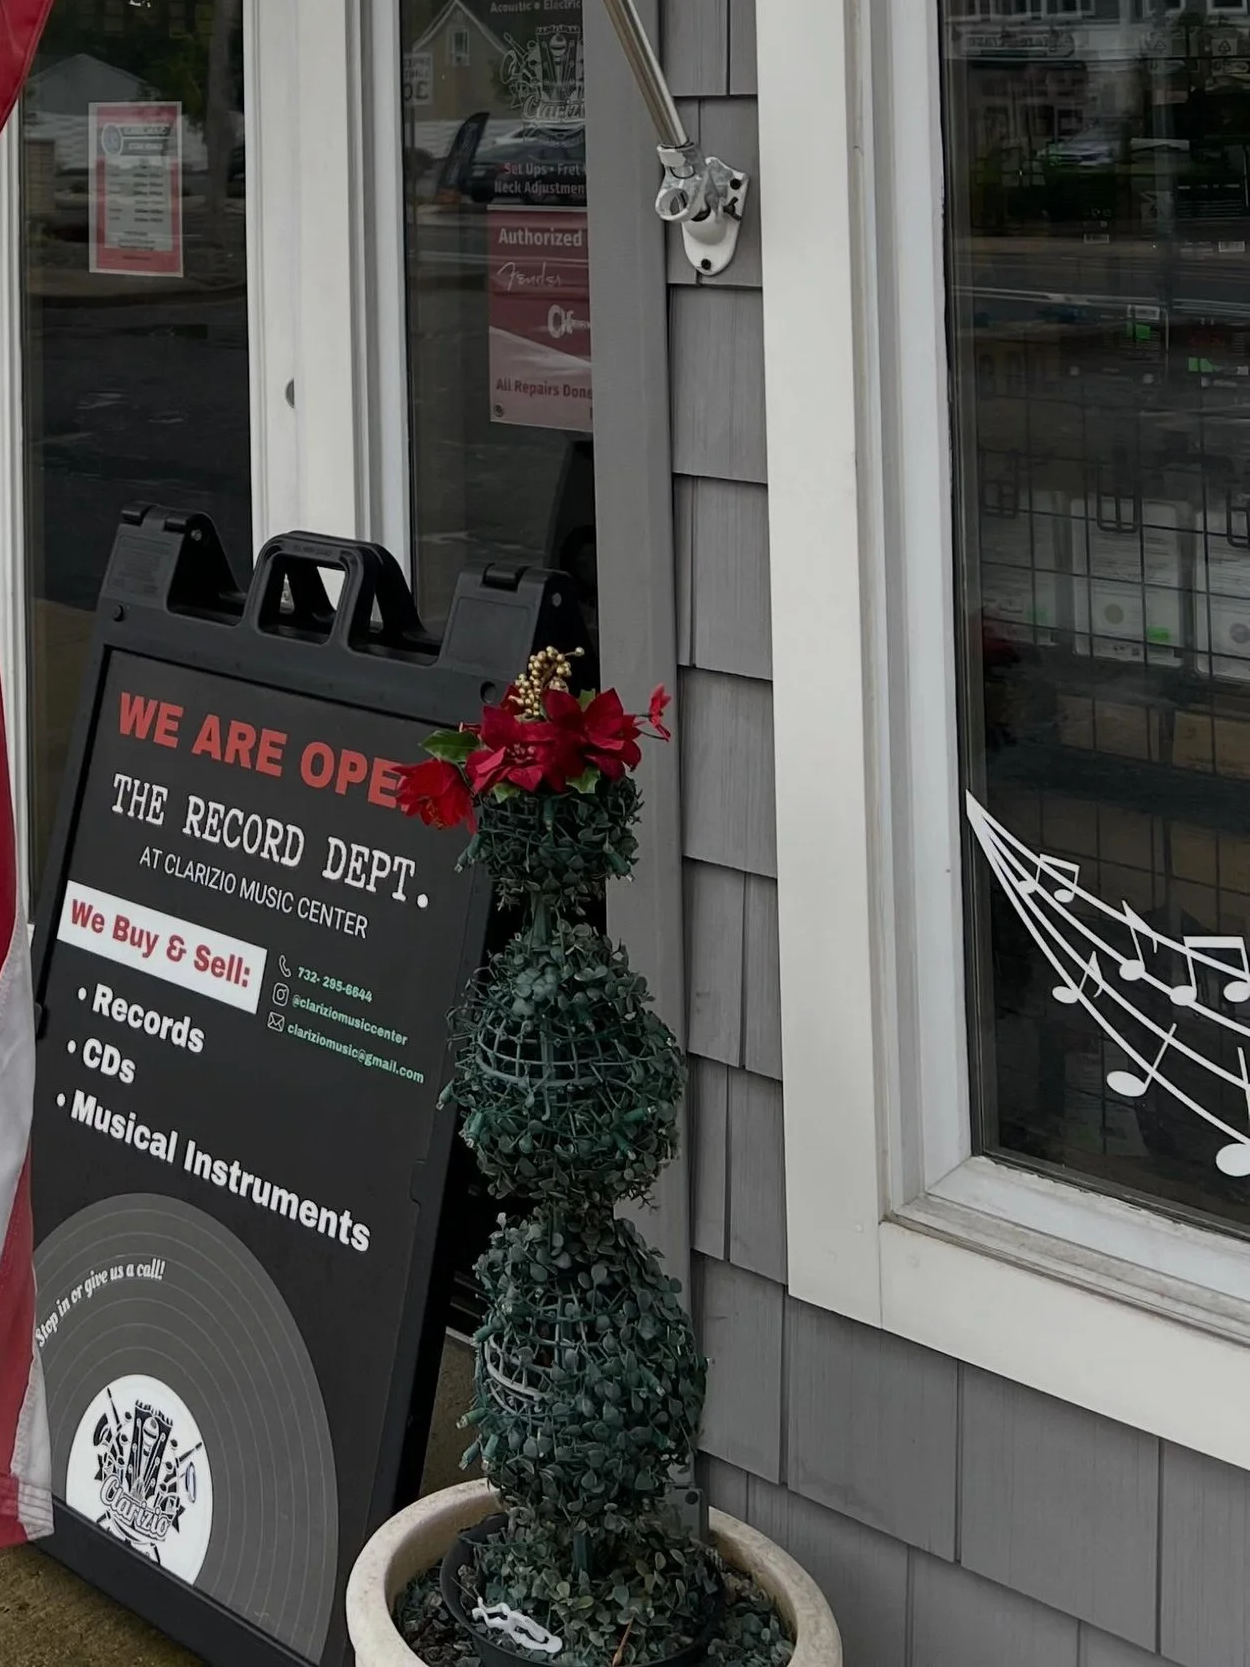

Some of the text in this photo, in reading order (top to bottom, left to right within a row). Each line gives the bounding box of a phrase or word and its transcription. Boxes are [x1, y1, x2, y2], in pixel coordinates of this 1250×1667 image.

[522, 94, 586, 121] Clariz
[524, 181, 587, 196] Adjustmen
[525, 163, 548, 178] Ups
[499, 227, 583, 247] Authorized
[496, 378, 512, 392] All
[514, 380, 560, 398] Repairs
[119, 691, 405, 811] WE ARE OPE
[111, 773, 429, 908] THE RECORD DEPT.
[139, 846, 368, 939] AT CLARIZIO MUSIC CENTER
[71, 899, 251, 987] We Buy & Sell:
[92, 983, 205, 1053] Records
[292, 995, 408, 1045] @clariziomusiccenter
[83, 1037, 136, 1084] CDs
[287, 1024, 425, 1084] clariziomusic@gmail.com
[71, 1089, 370, 1252] Musical Instruments
[35, 1258, 166, 1348] Stop in or give us a call!
[100, 1473, 172, 1540] Clarizio
